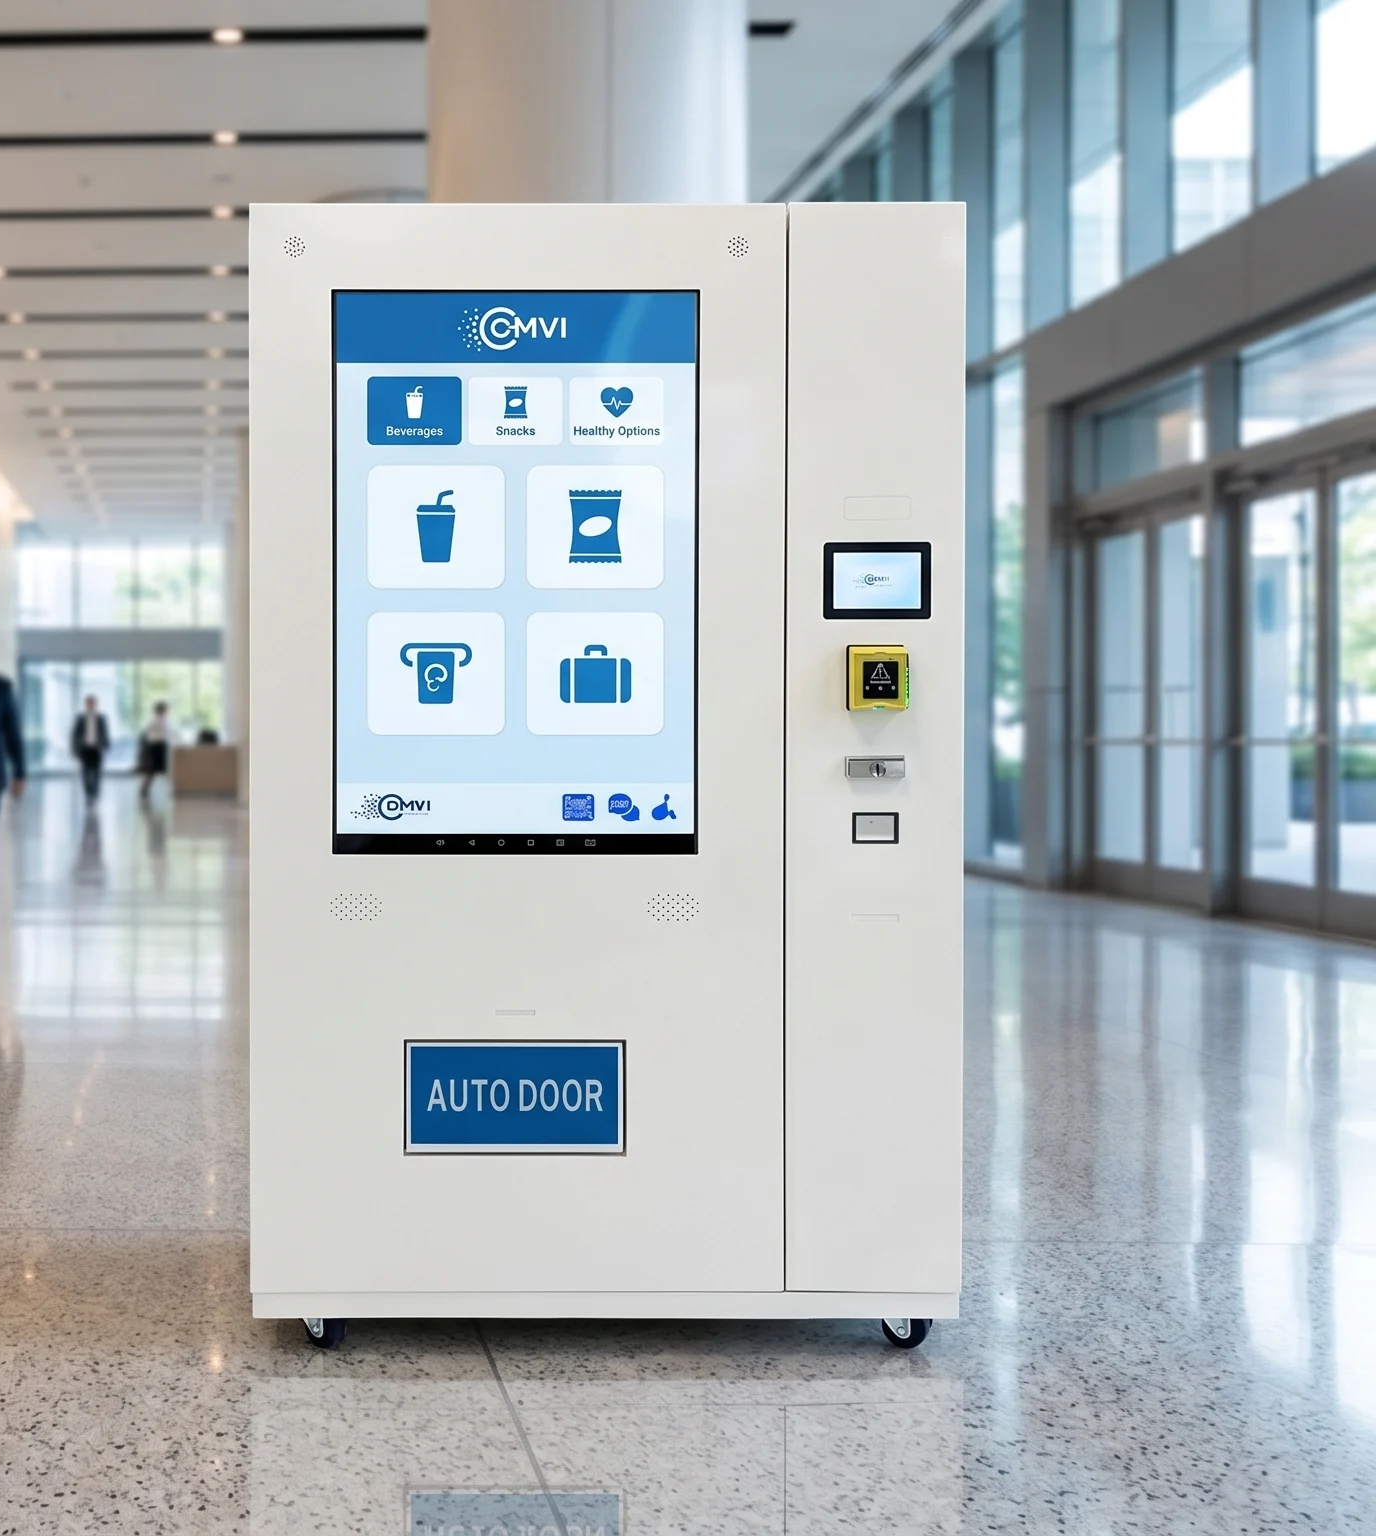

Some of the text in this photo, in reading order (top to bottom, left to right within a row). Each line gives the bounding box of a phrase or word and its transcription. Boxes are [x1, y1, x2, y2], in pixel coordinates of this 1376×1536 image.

[386, 425, 444, 439] Beverages
[495, 425, 536, 437] Snacks
[573, 425, 661, 439] Healthy Options
[426, 1078, 604, 1112] AUTO DOOR
